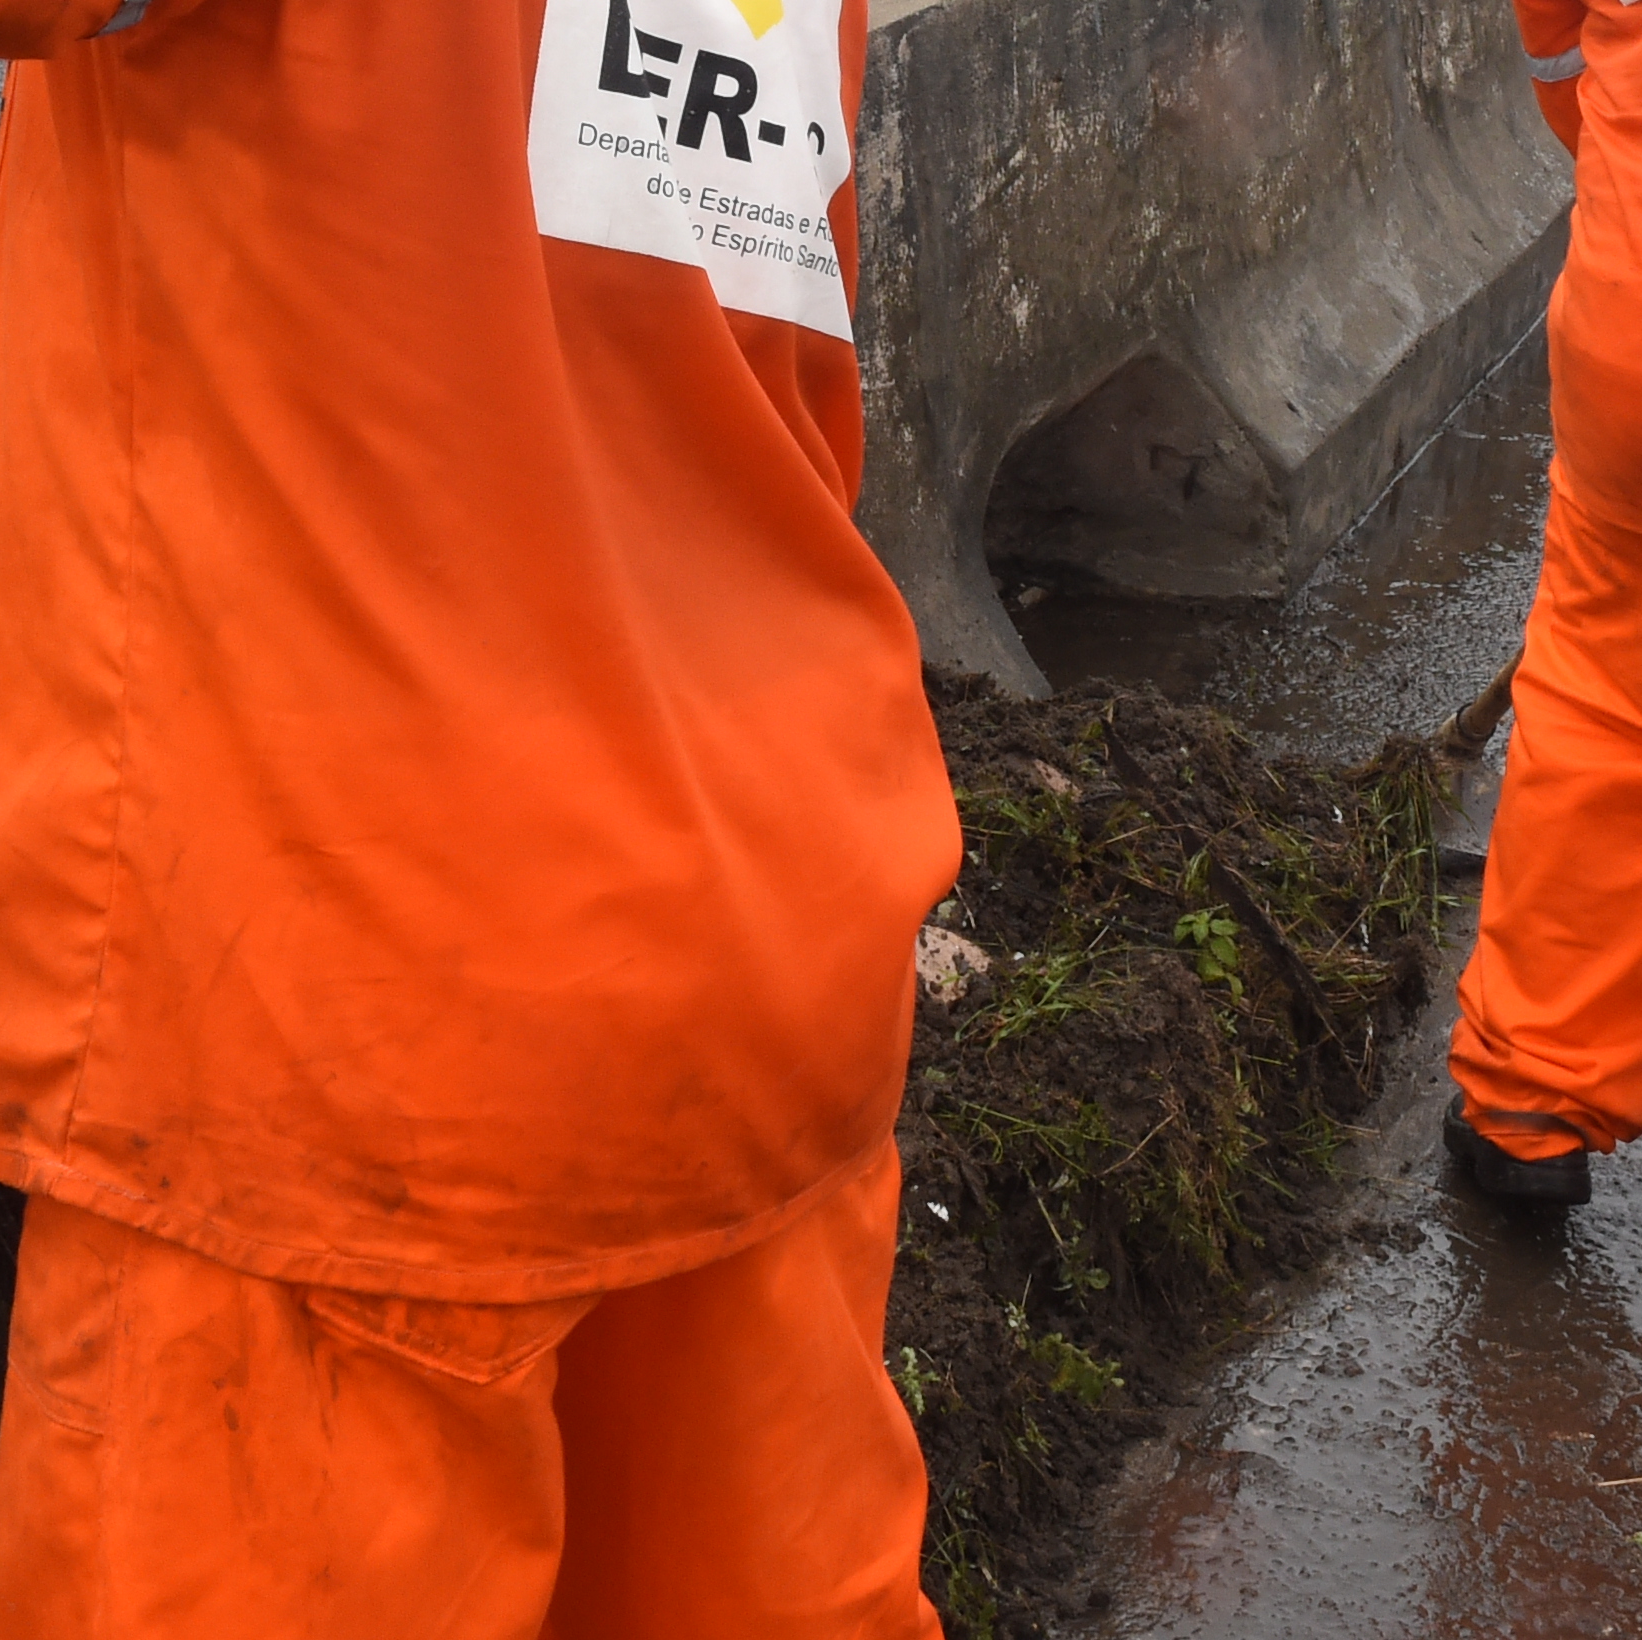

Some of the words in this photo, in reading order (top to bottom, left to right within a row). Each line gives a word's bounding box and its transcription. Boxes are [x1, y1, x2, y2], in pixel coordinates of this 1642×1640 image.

[578, 122, 670, 164] Departa
[646, 173, 674, 198] do
[699, 187, 795, 230] Estradas
[798, 216, 809, 234] e
[711, 223, 794, 263] Espírito
